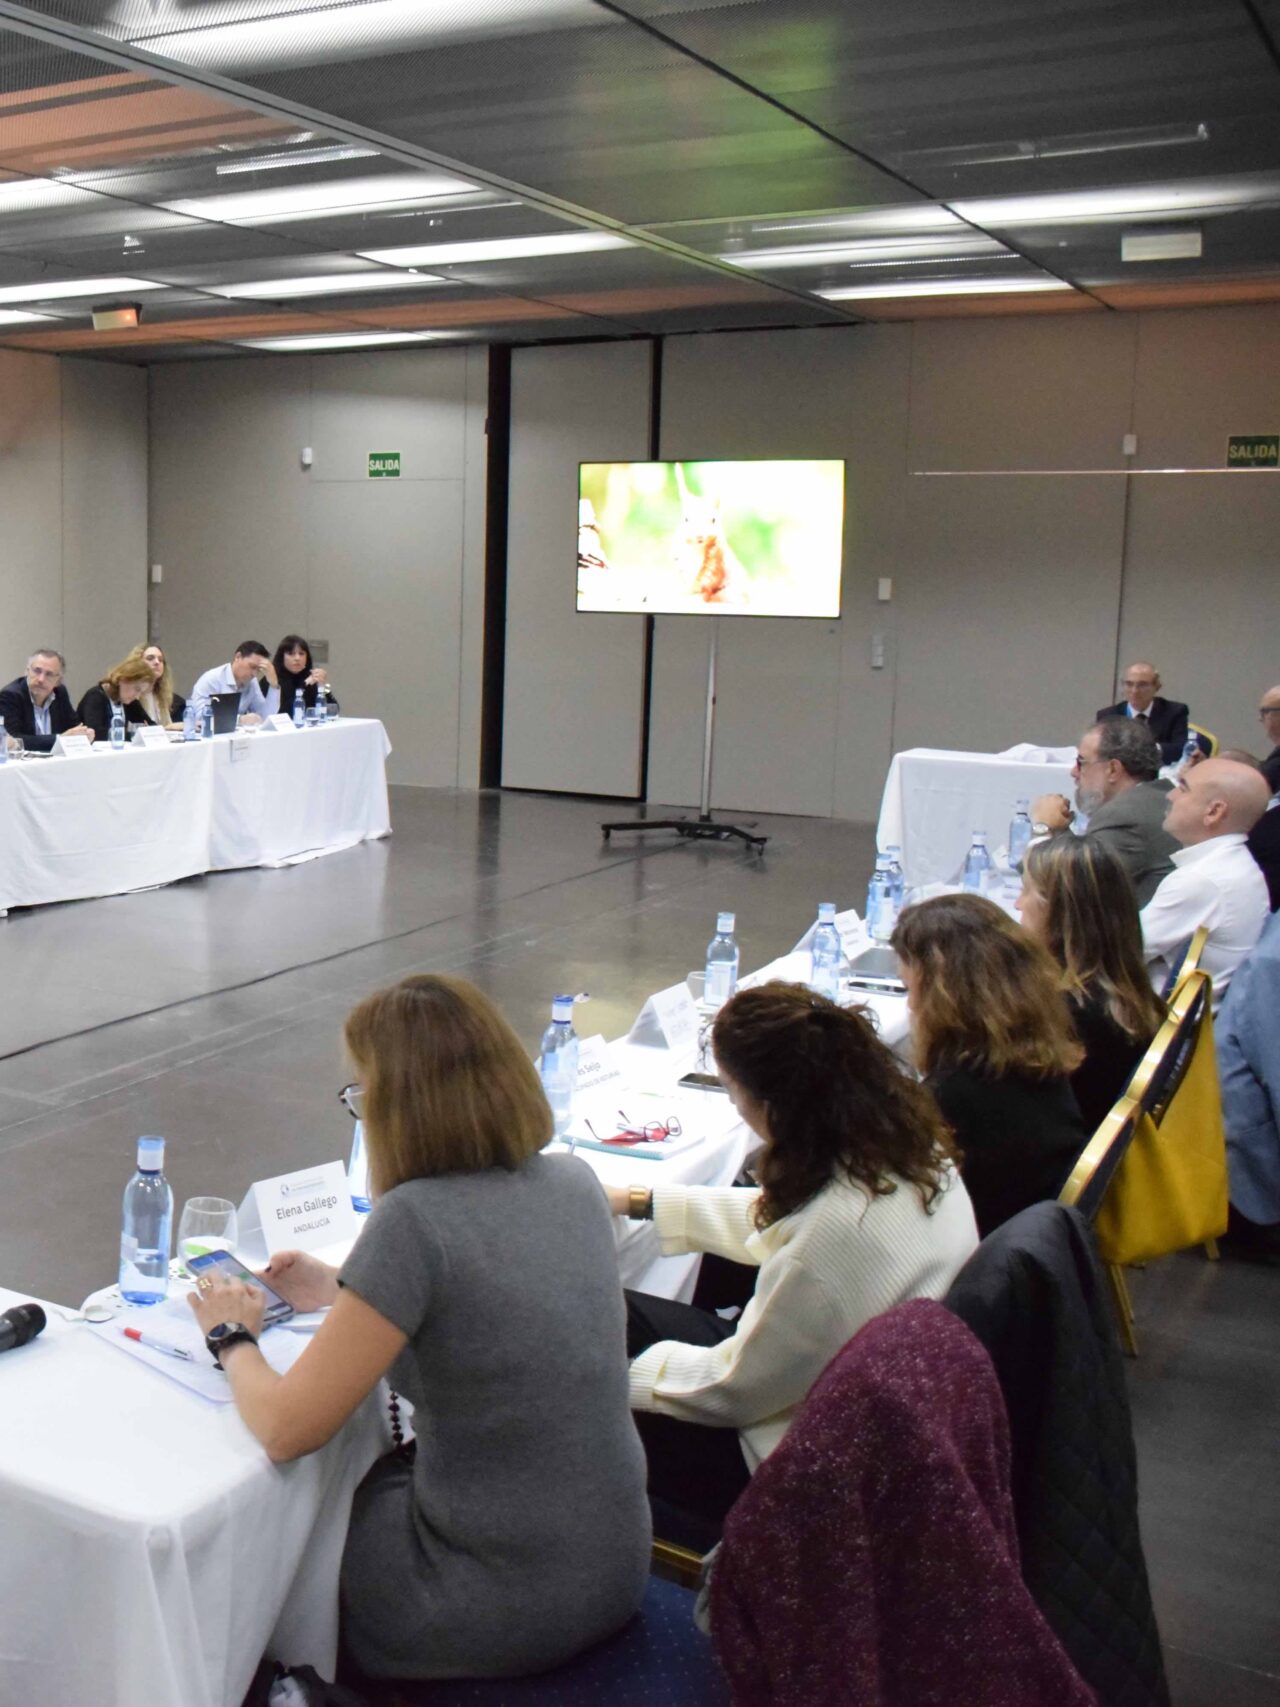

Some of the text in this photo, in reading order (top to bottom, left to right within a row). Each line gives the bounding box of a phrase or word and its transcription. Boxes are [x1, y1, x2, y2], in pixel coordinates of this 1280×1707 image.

[1229, 444, 1277, 459] SALIDA
[369, 459, 400, 471] SALIDA
[276, 1196, 337, 1220] Elena Gallego
[293, 1217, 331, 1234] ANDALUCÍA
